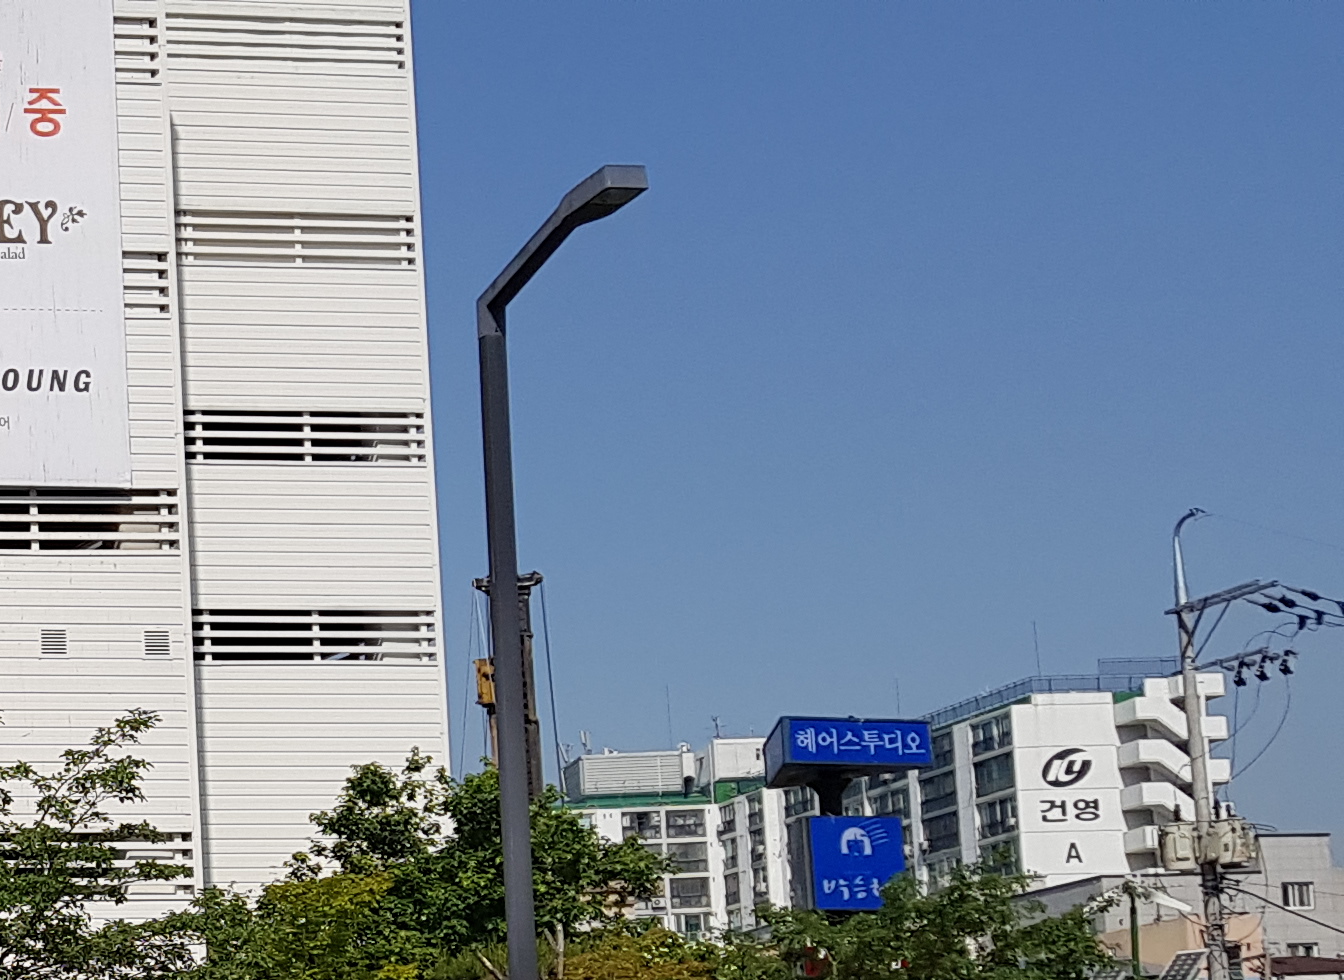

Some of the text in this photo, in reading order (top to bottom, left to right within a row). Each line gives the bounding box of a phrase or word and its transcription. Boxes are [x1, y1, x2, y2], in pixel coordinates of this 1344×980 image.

[795, 727, 926, 756] 헤어스투디오
[1039, 798, 1100, 823] 건영
[1066, 842, 1083, 864] A
